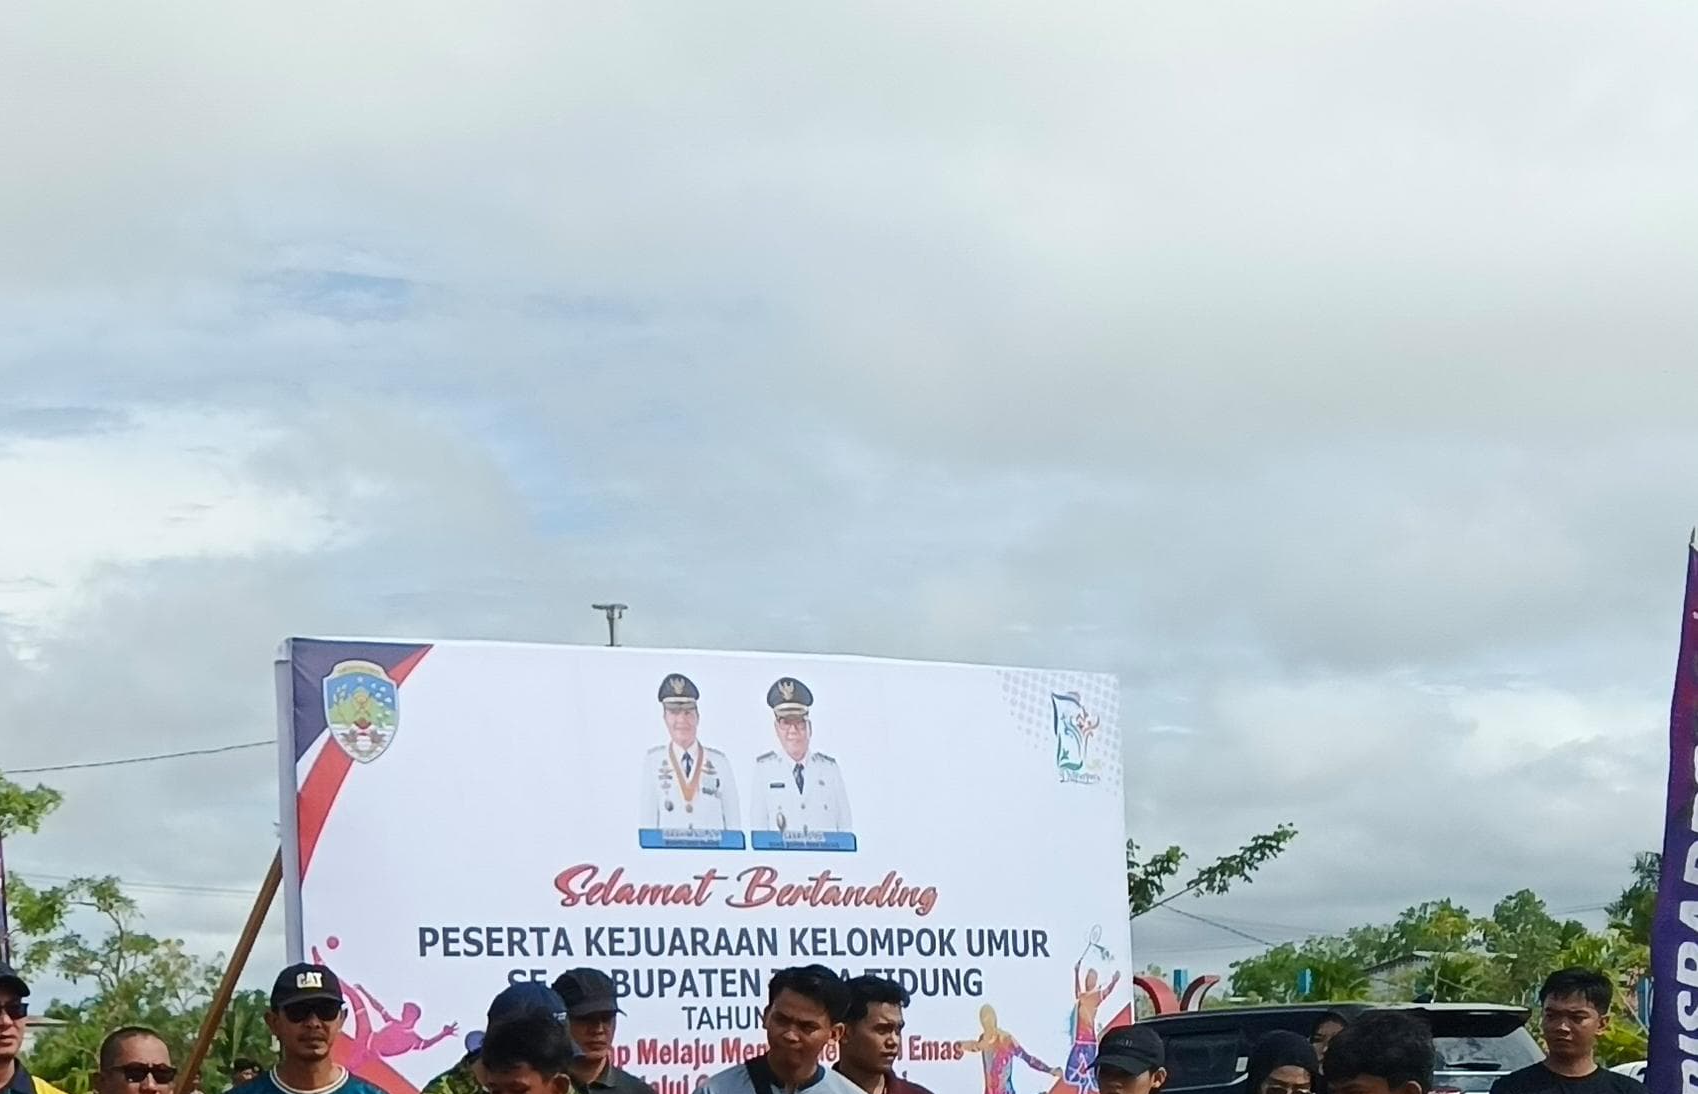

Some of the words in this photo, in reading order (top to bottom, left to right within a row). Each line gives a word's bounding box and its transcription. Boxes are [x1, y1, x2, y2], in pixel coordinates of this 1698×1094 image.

[554, 864, 728, 907] Selamat
[725, 866, 938, 916] Bertanding
[418, 927, 574, 957] PESERTA
[585, 927, 778, 957] KEJUARAAN
[790, 927, 956, 957] KELOMPOK
[967, 928, 1050, 958] UMUR
[296, 971, 323, 989] CAT
[681, 1005, 766, 1030] TAHUN
[637, 1037, 715, 1070] Melaju
[908, 1035, 964, 1061] Emas
